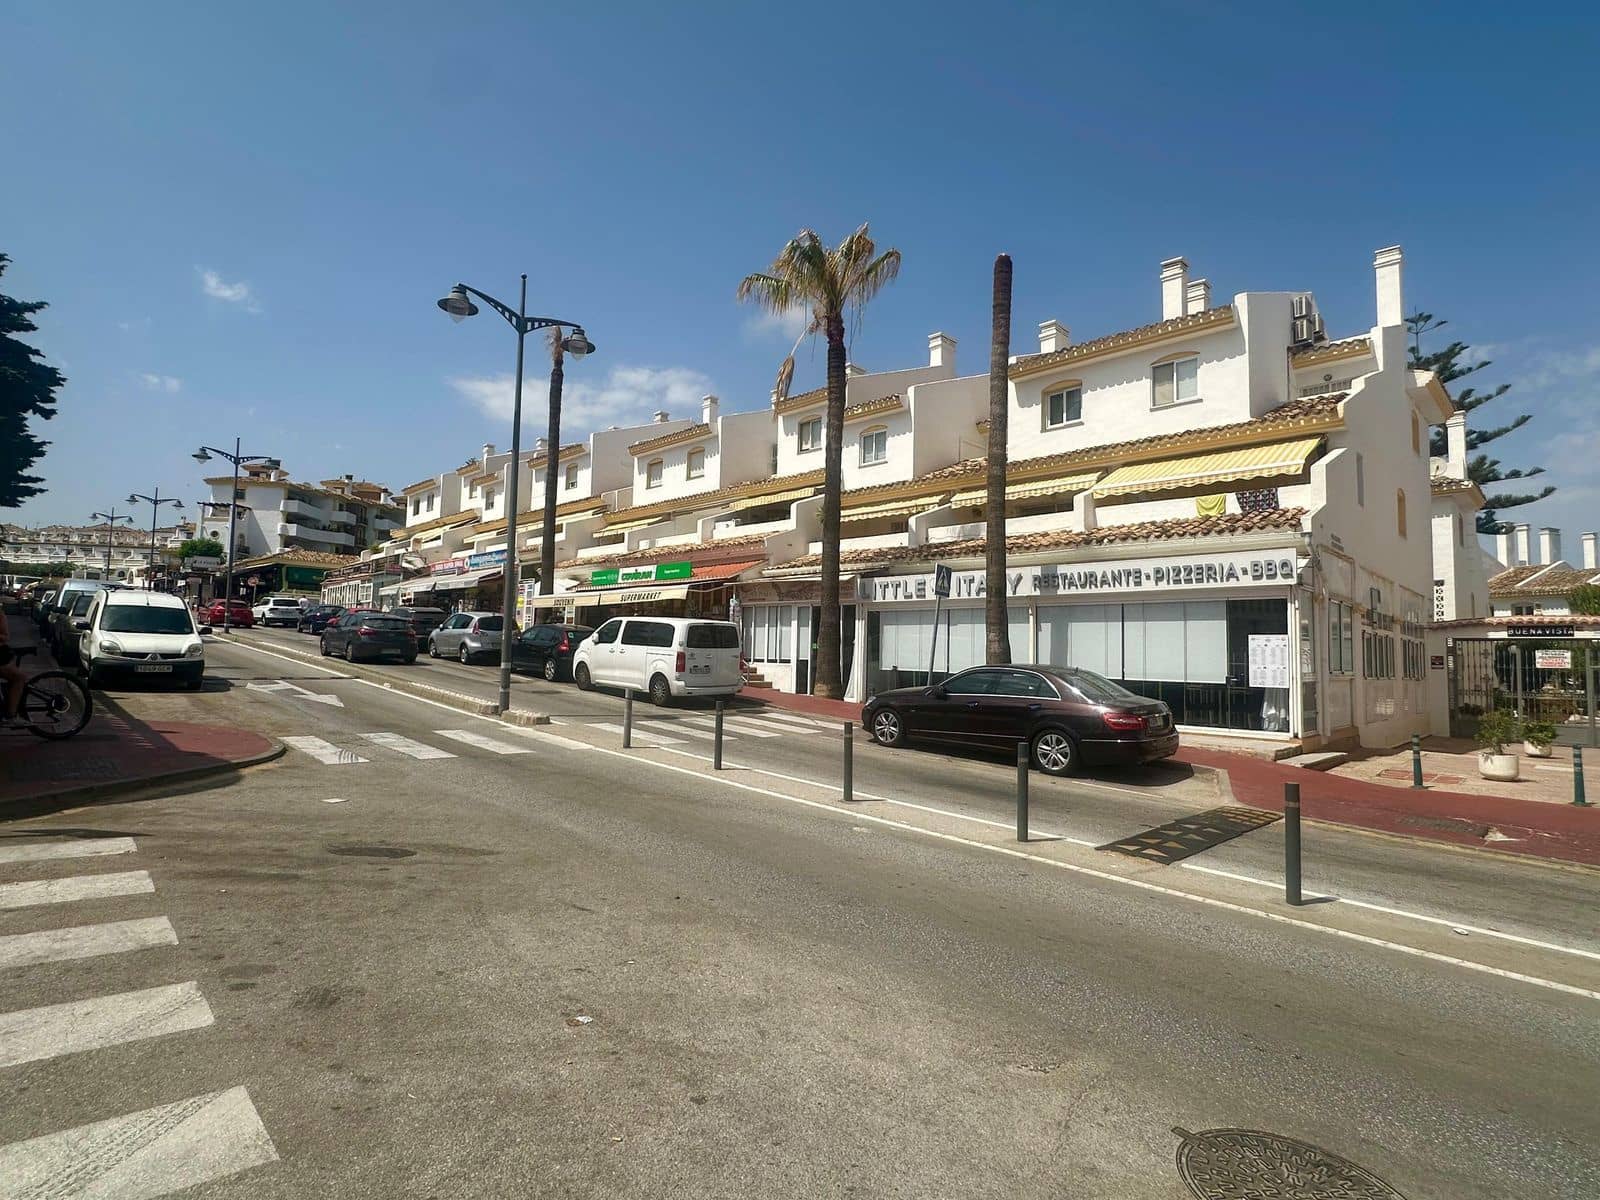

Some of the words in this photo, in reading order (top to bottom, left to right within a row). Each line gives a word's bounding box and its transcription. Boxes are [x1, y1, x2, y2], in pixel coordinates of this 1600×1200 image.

[1032, 566, 1143, 592] RESTAURANTE
[1152, 561, 1241, 586] PIZZERIA
[1249, 558, 1295, 581] BBQ
[620, 591, 662, 603] SUPERMARKET
[861, 578, 927, 602] LITTLE
[956, 572, 1023, 599] ITAY
[1507, 627, 1543, 636] BUENA
[1545, 627, 1575, 636] VISTA
